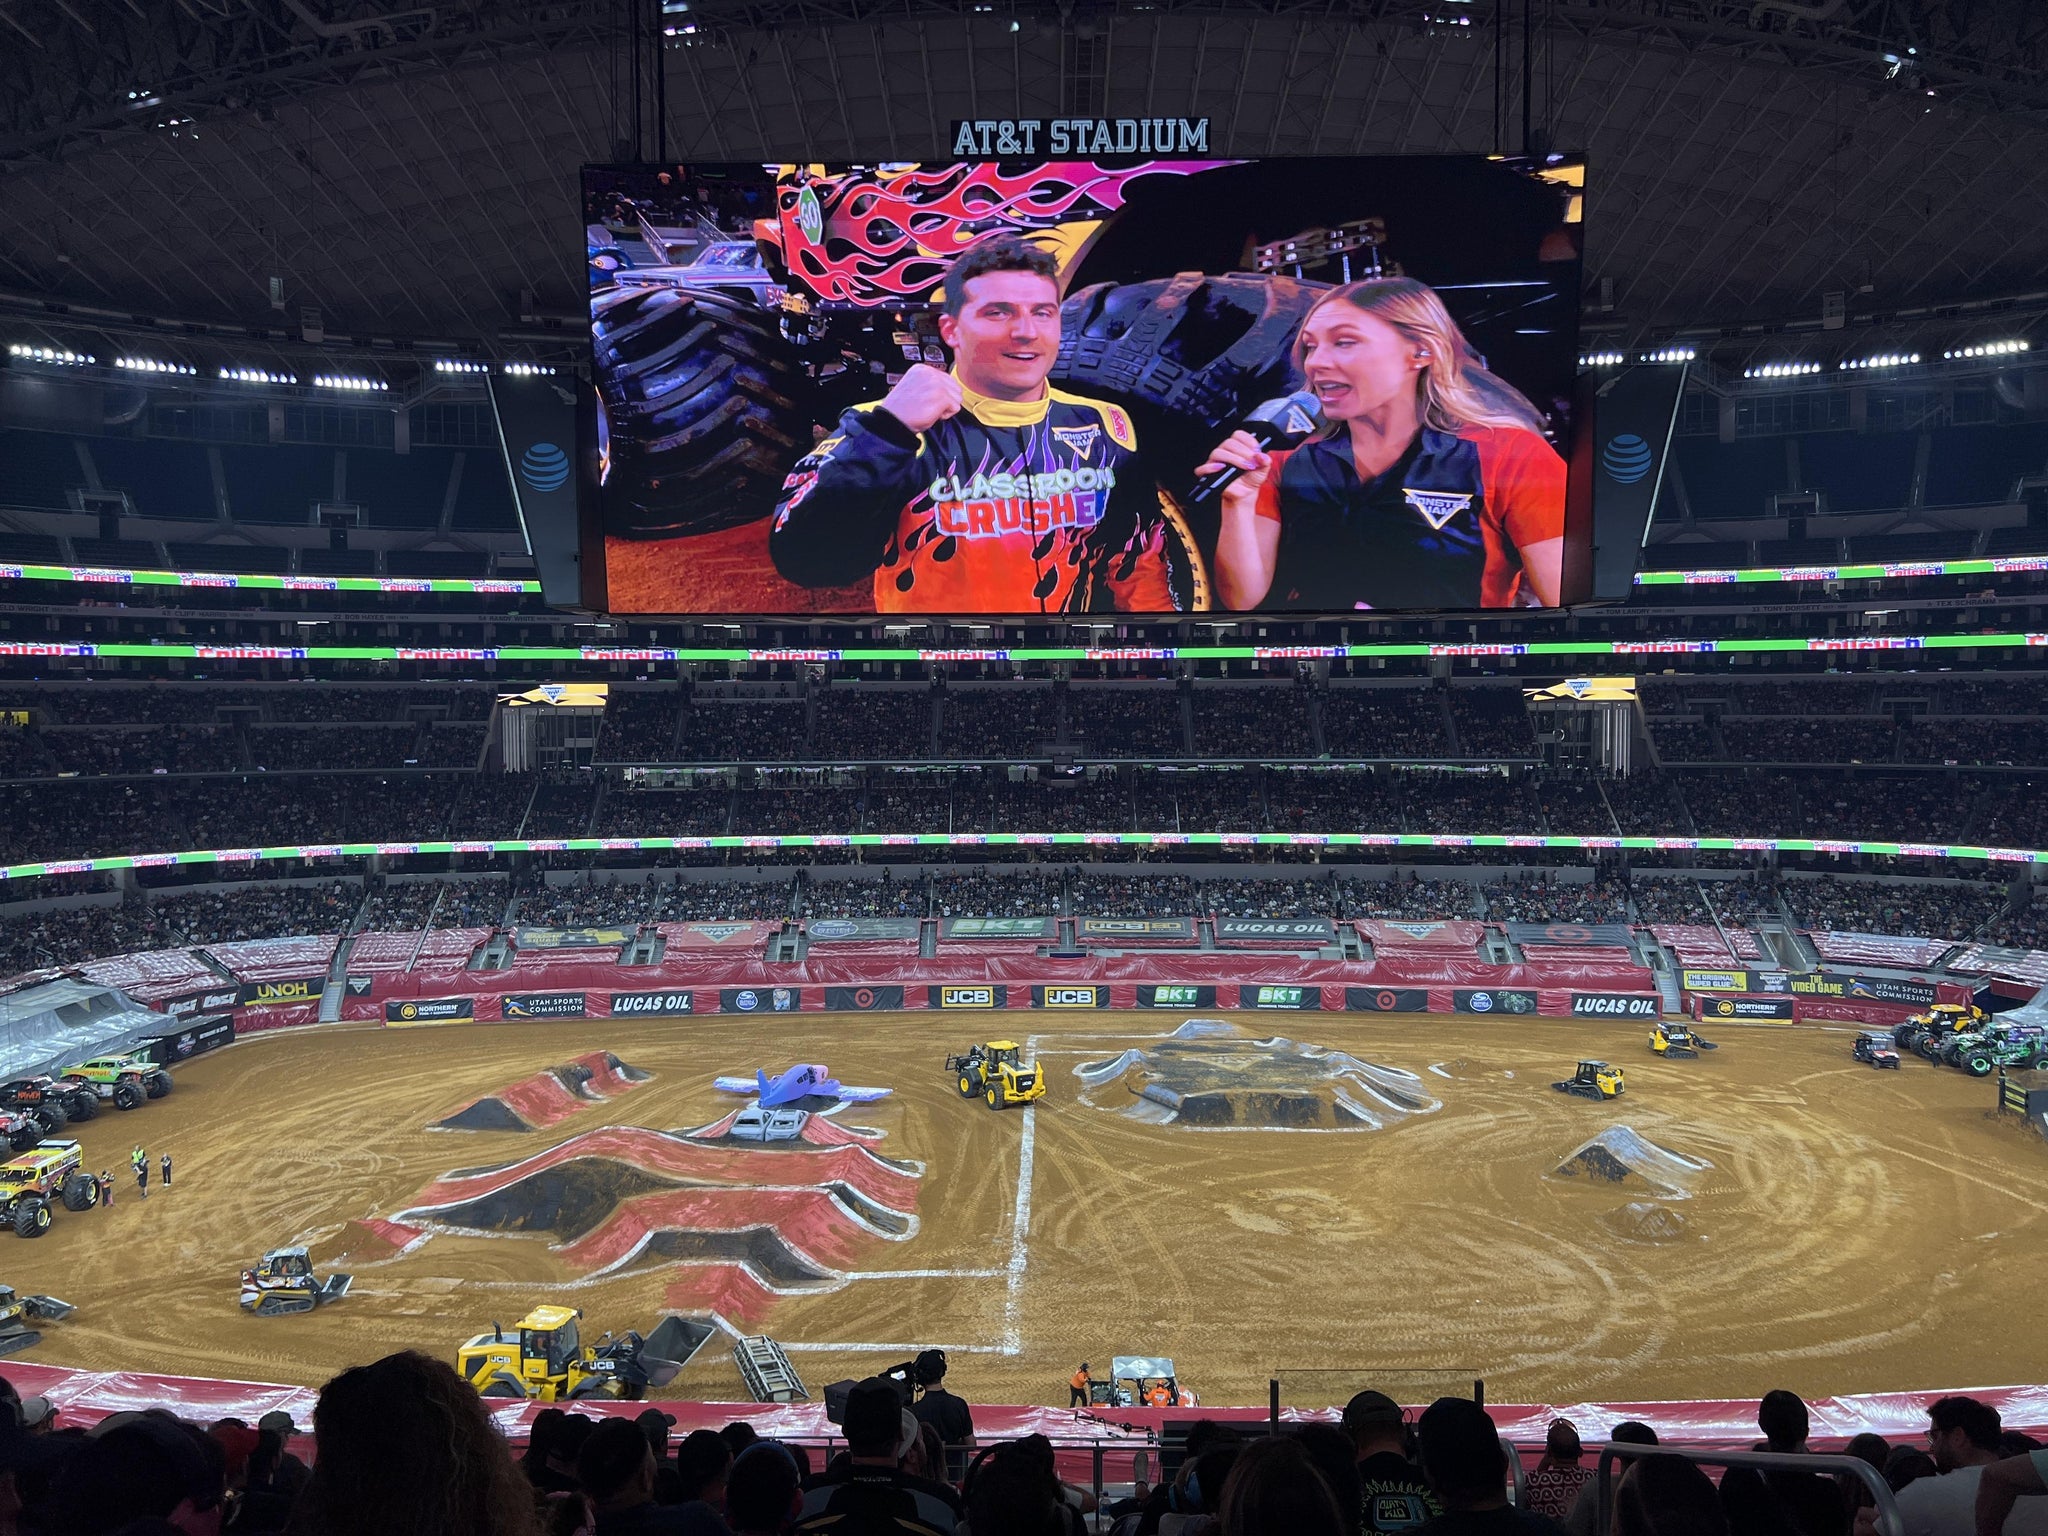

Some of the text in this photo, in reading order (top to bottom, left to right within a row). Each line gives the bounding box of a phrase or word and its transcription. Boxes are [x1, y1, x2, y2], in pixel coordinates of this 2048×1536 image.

[953, 119, 1208, 155] AT&T STADIUM
[1053, 428, 1101, 441] MONSTER
[1072, 439, 1091, 447] JAM
[929, 467, 1116, 501] CLASSROOM
[1405, 495, 1471, 509] MONSTER
[1428, 505, 1453, 515] JAM
[954, 918, 1044, 931] BKT
[1090, 921, 1147, 931] JCB
[1223, 923, 1289, 933] LUCAS
[1809, 975, 1823, 983] THE
[257, 982, 308, 998] UNOH
[1791, 981, 1815, 993] VIDEO
[1817, 983, 1843, 994] GAME
[1876, 983, 1934, 996] UTAH SPORTS
[553, 997, 583, 1005] SPORTS
[945, 989, 990, 1004] JCB
[1048, 989, 1093, 1004] JCB
[1155, 988, 1197, 1001] BKT
[1259, 988, 1301, 1001] BKT
[1876, 991, 1934, 1003] COMMISSION
[529, 1005, 583, 1013] COMMISSION
[614, 996, 664, 1011] LUCAS
[1574, 998, 1628, 1013] LUCAS
[490, 1356, 511, 1364] JCB
[589, 1361, 615, 1370] JCB
[1380, 1500, 1407, 1510] DIRTY
[1384, 1508, 1406, 1518] KID
